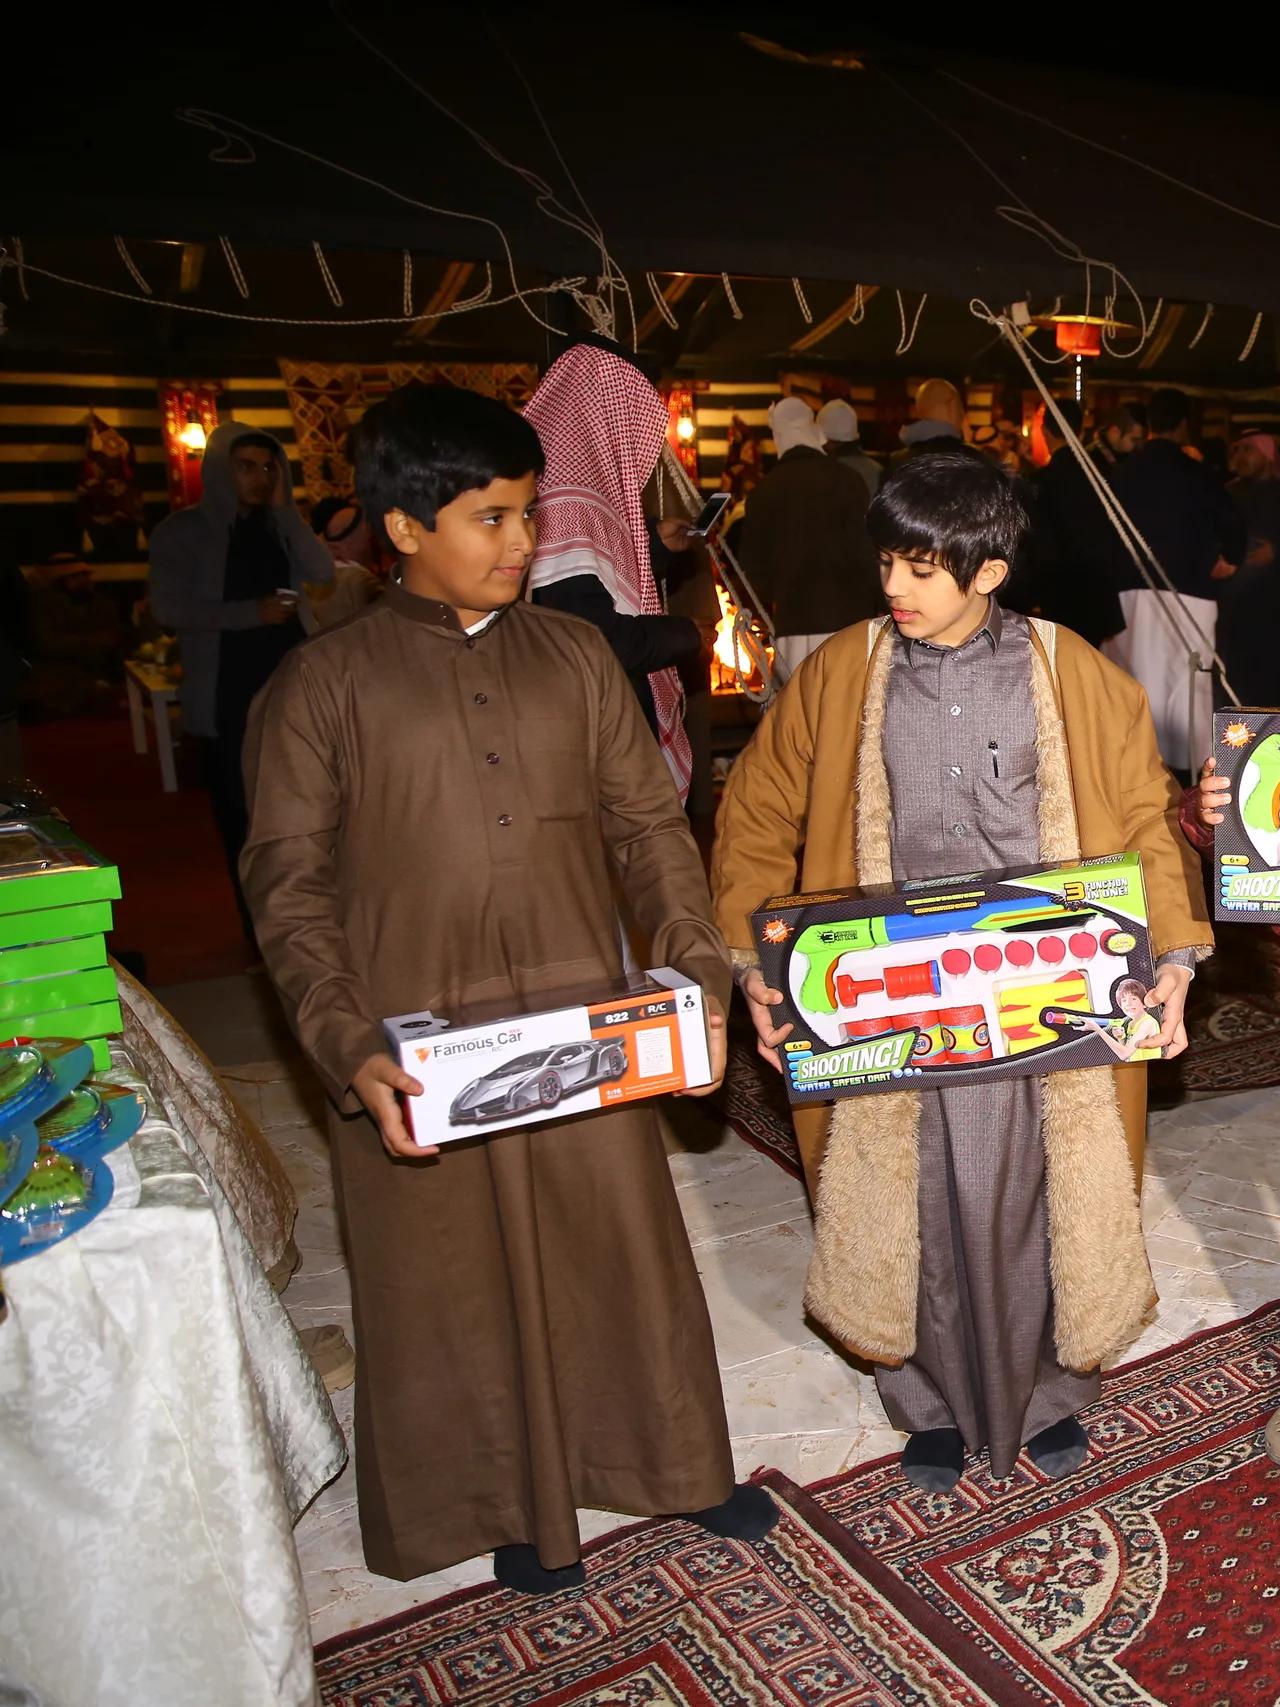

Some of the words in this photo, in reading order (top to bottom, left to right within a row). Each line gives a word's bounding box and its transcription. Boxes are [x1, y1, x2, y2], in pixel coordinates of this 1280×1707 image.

[1064, 881, 1086, 902] 3
[1085, 877, 1128, 891] FUNCTION
[1087, 889, 1100, 900] IN
[1102, 886, 1128, 898] ONE!
[1226, 900, 1260, 911] WATER
[647, 1003, 667, 1014] R/C
[605, 1011, 629, 1024] 822
[433, 1038, 493, 1058] Famous
[497, 1032, 522, 1045] Car
[801, 1038, 905, 1079] SHOOTING!
[798, 1080, 831, 1092] WATER
[832, 1075, 866, 1087] SAFEST
[867, 1072, 891, 1083] DART
